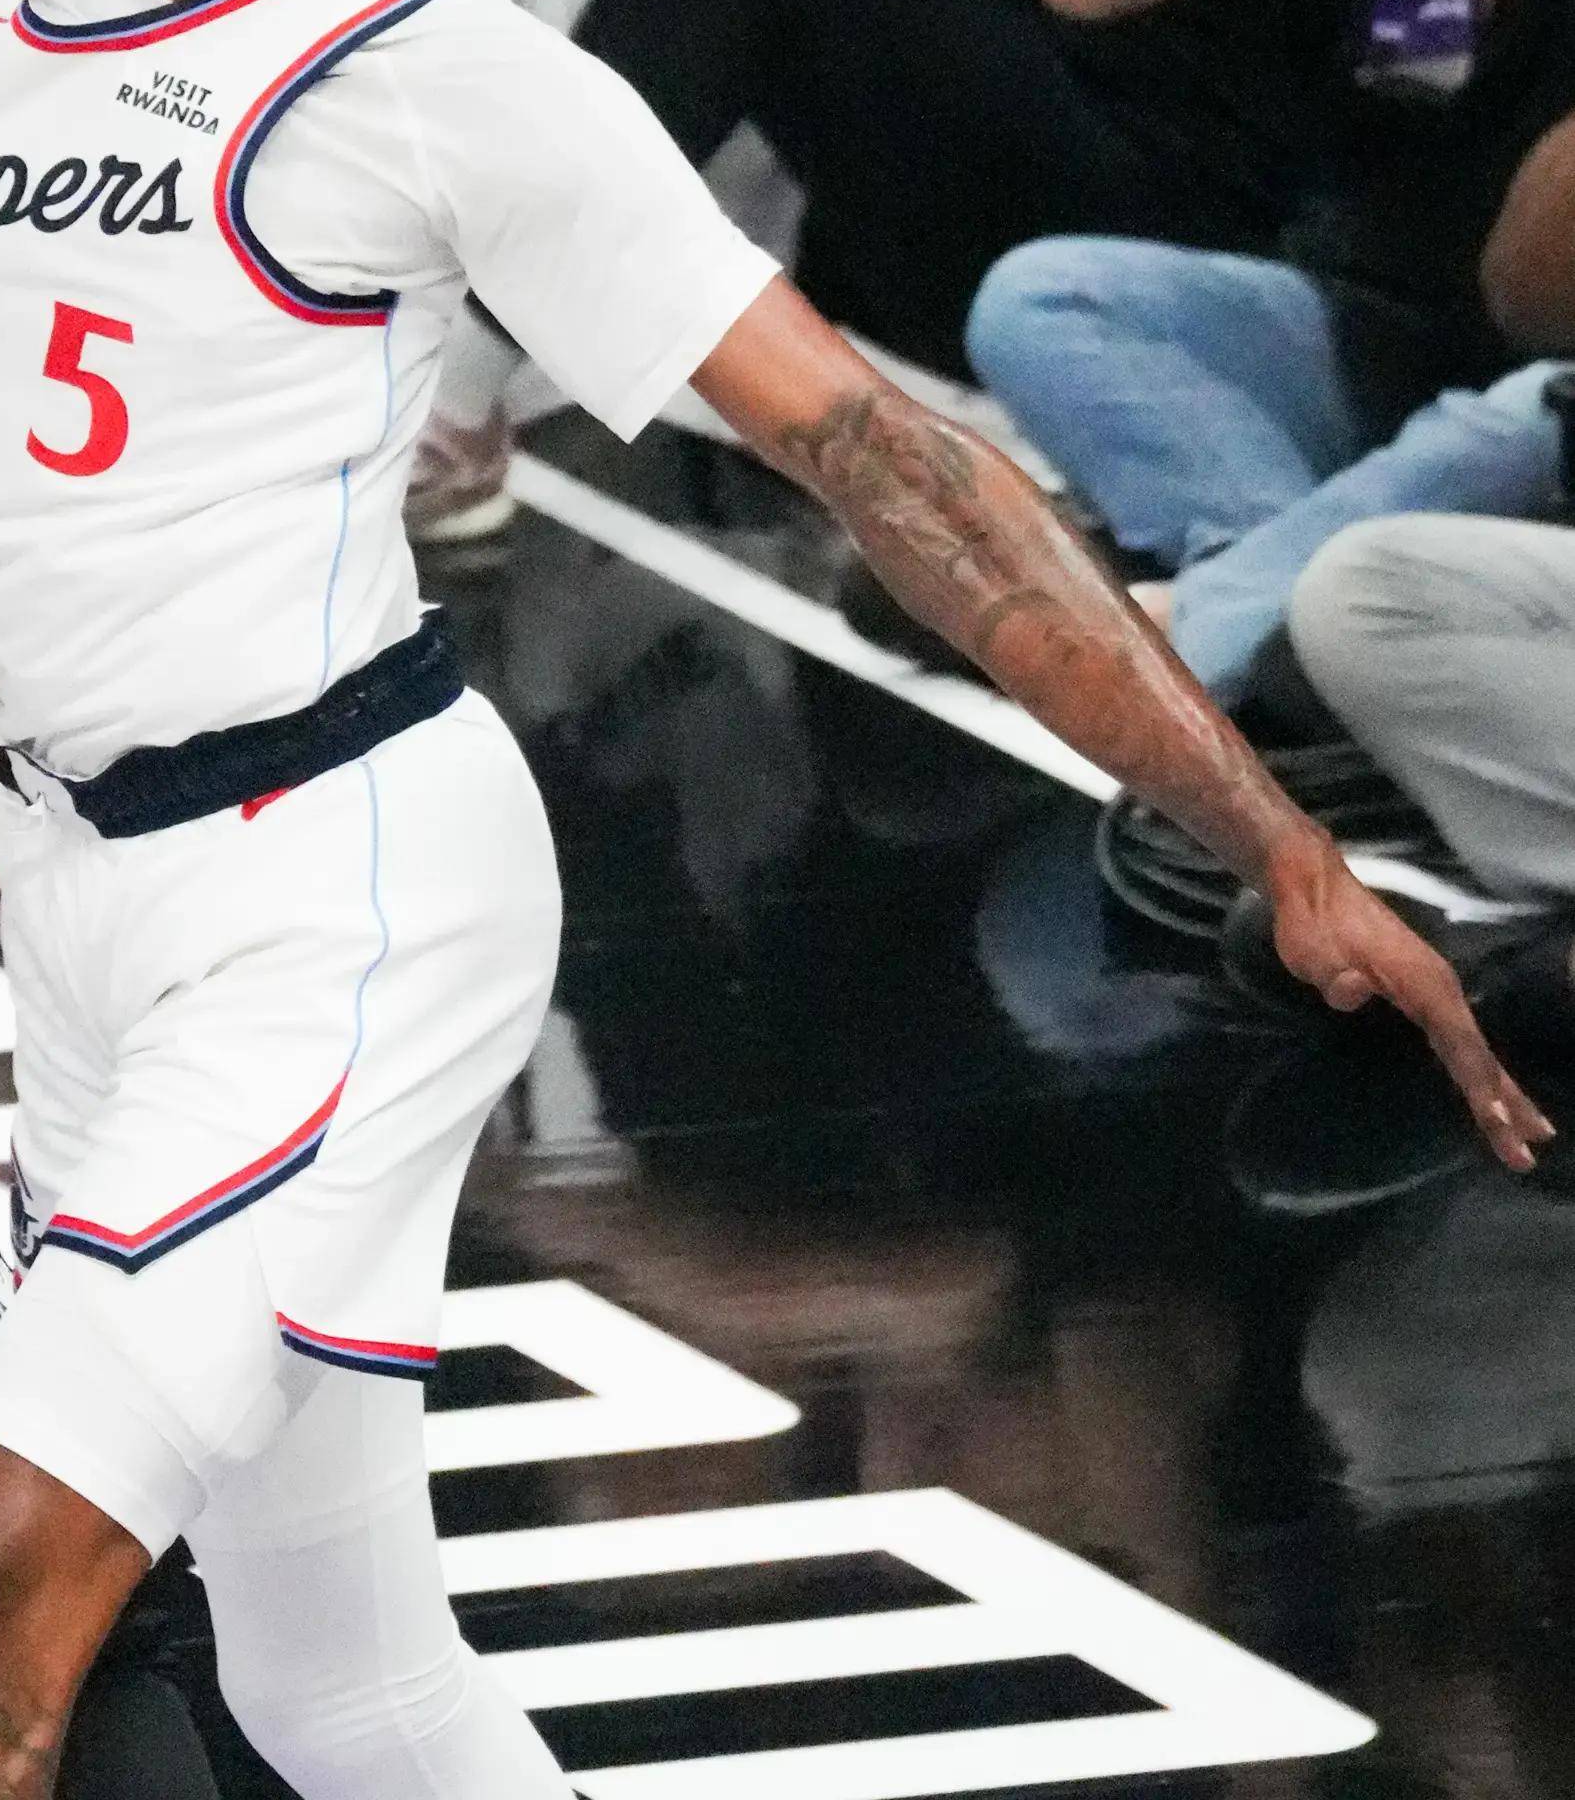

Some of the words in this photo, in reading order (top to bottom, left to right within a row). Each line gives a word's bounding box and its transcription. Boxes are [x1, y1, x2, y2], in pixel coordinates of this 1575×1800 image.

[115, 82, 220, 136] RWANDA
[152, 70, 213, 107] VISIT
[26, 301, 134, 478] 5
